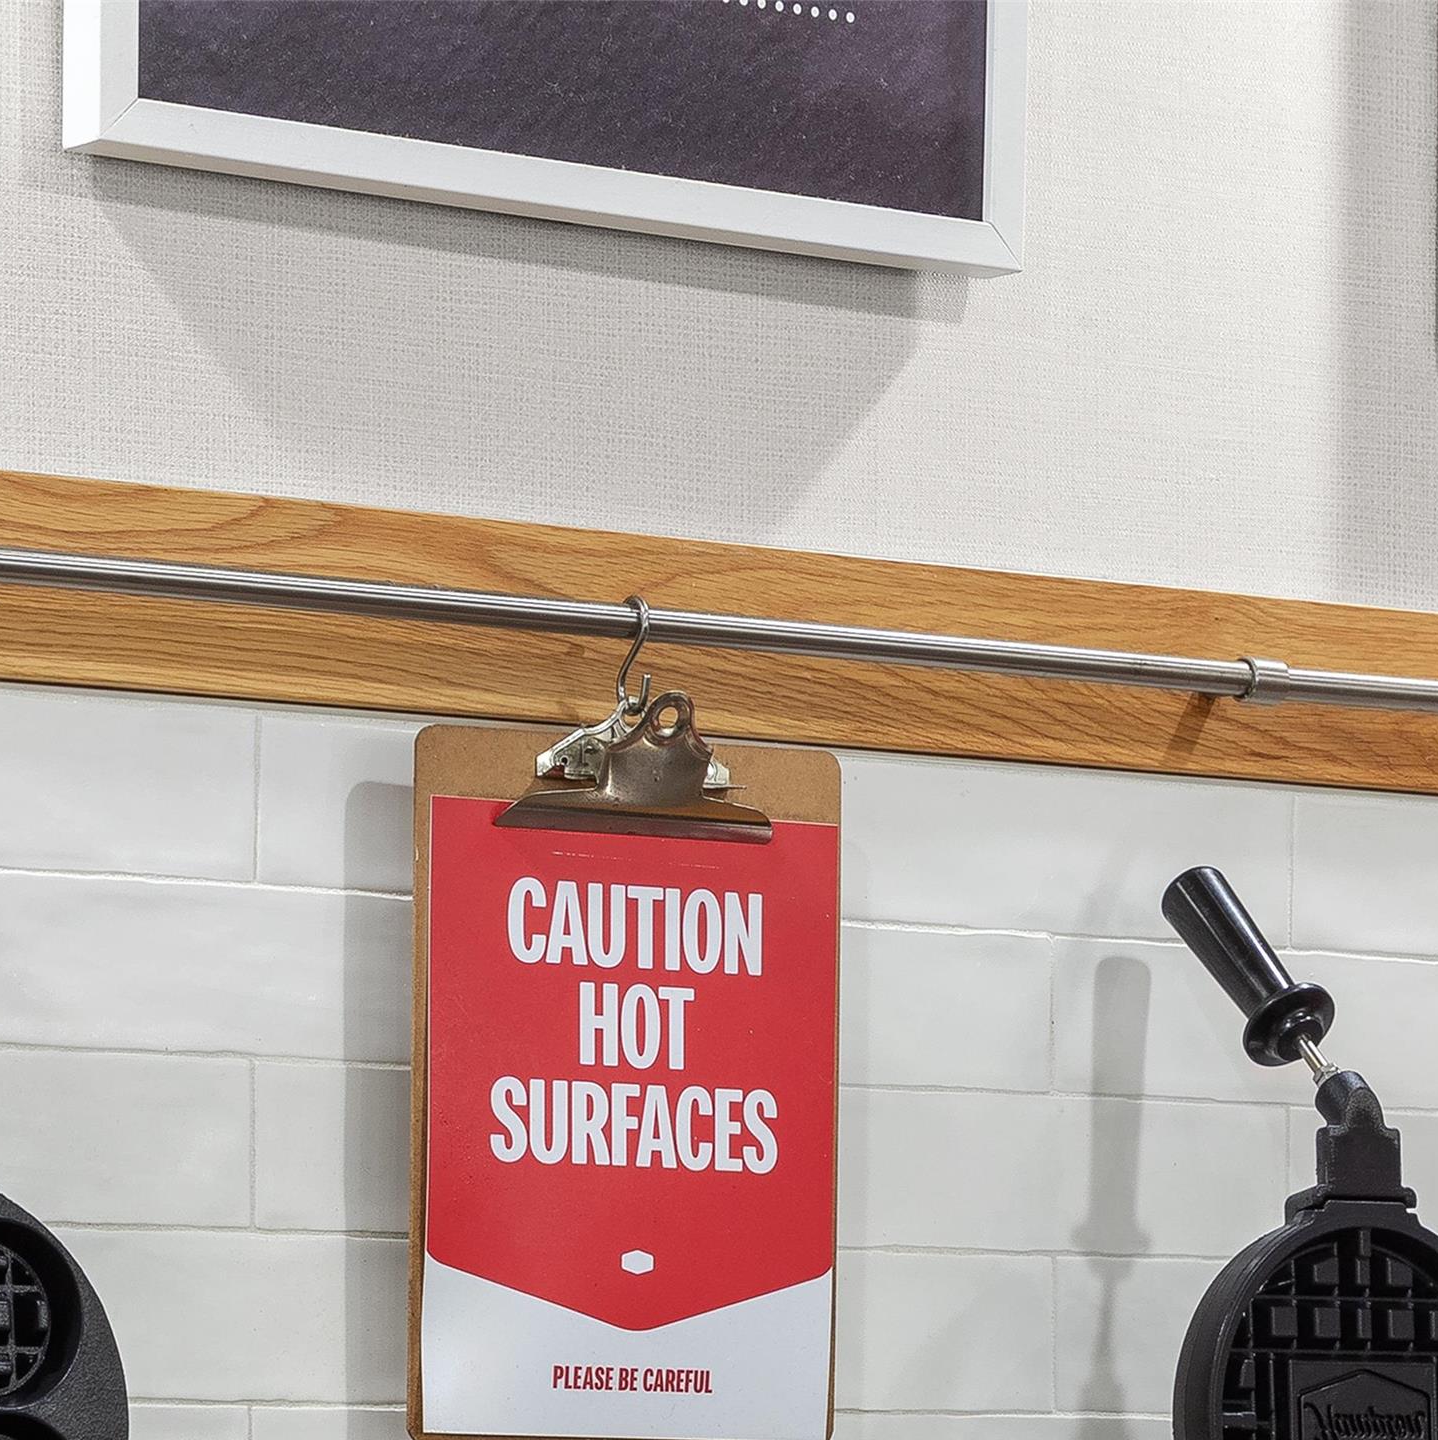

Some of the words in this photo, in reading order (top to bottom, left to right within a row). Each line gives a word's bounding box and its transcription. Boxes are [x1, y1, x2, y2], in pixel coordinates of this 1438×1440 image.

[507, 876, 763, 977] CAUTION
[579, 981, 695, 1070] HOT
[489, 1075, 779, 1175] SURFACES
[551, 1365, 615, 1393] PLEASE
[618, 1366, 639, 1393] BE
[643, 1367, 713, 1395] CAREFUL
